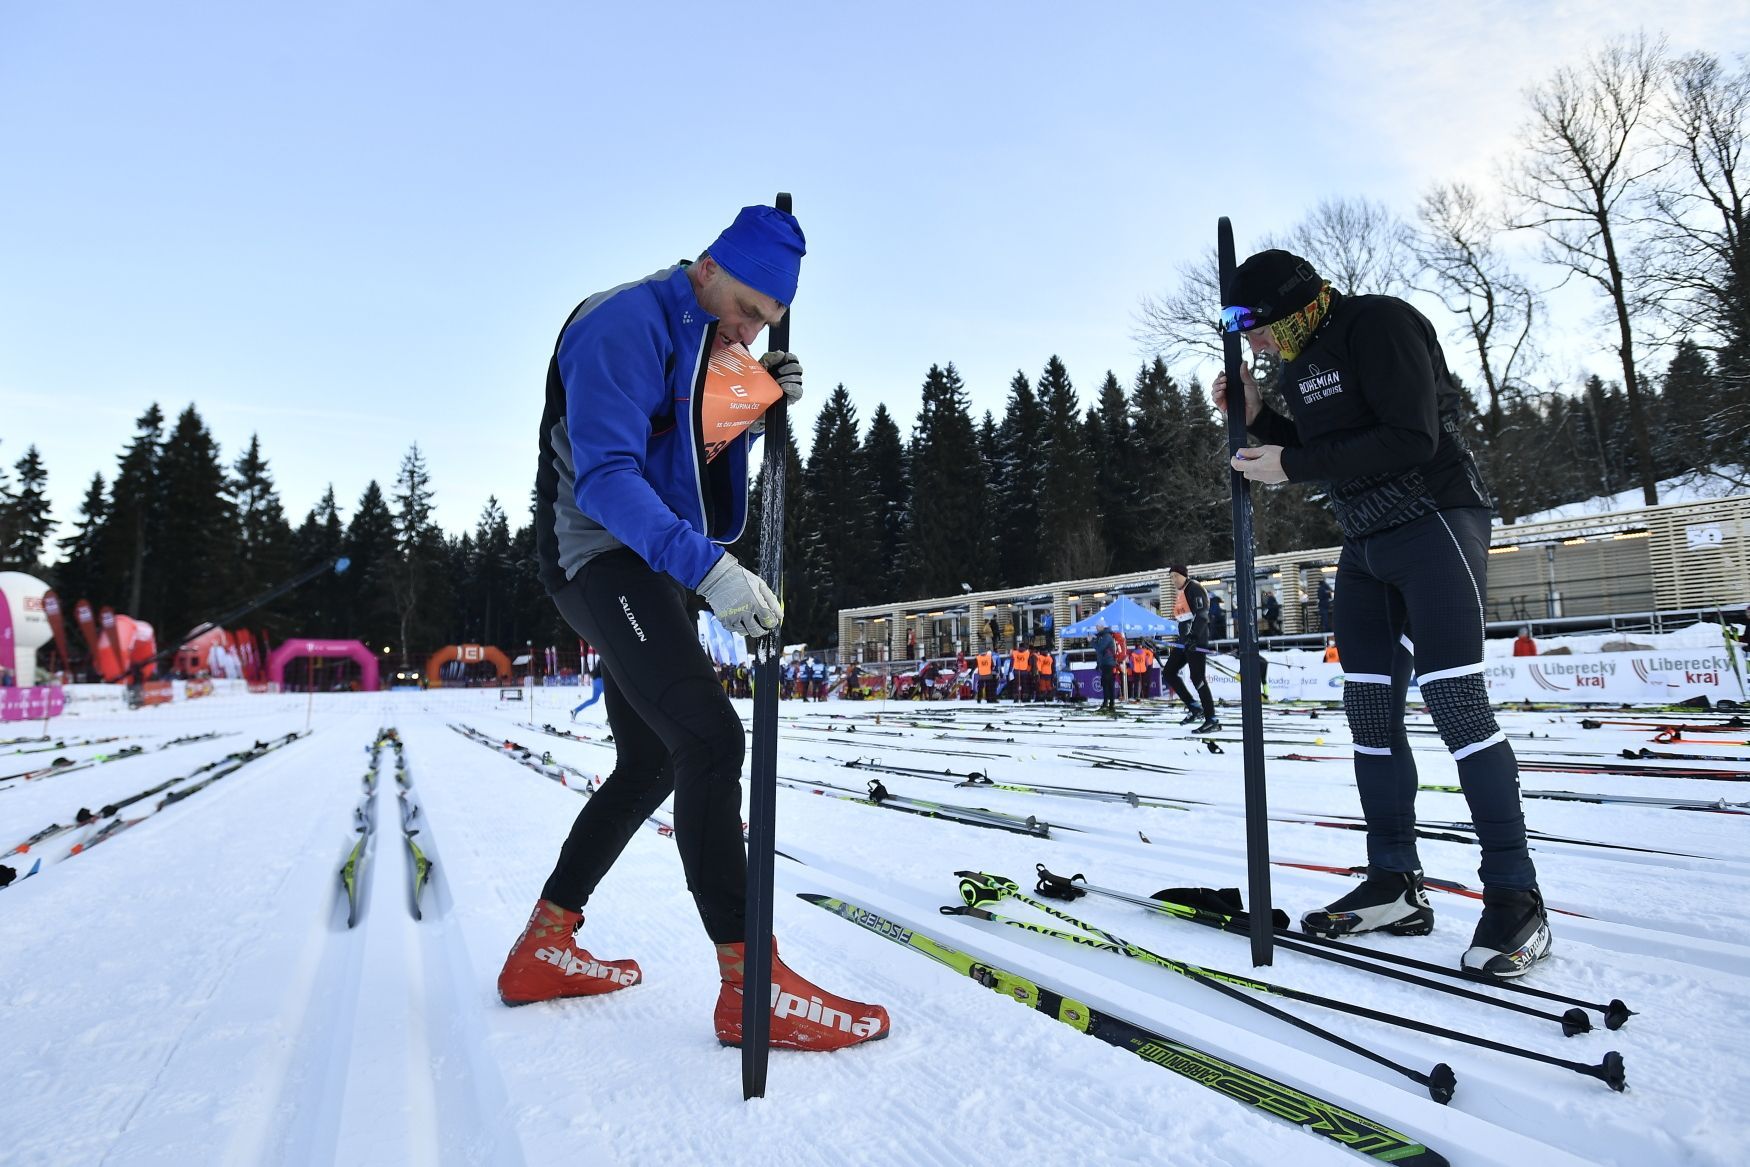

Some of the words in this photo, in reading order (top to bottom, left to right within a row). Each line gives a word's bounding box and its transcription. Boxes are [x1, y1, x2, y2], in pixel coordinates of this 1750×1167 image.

[1299, 371, 1340, 395] BOHEMIAN
[1304, 392, 1324, 405] COFFEE
[1322, 385, 1343, 398] HOUSE
[618, 595, 648, 643] SALOMON
[1543, 660, 1616, 676] Liberecký
[1685, 670, 1720, 686] kraj
[1576, 674, 1605, 689] kraj
[858, 909, 914, 944] FISCHER
[534, 946, 640, 987] alpina
[734, 982, 882, 1038] lpina
